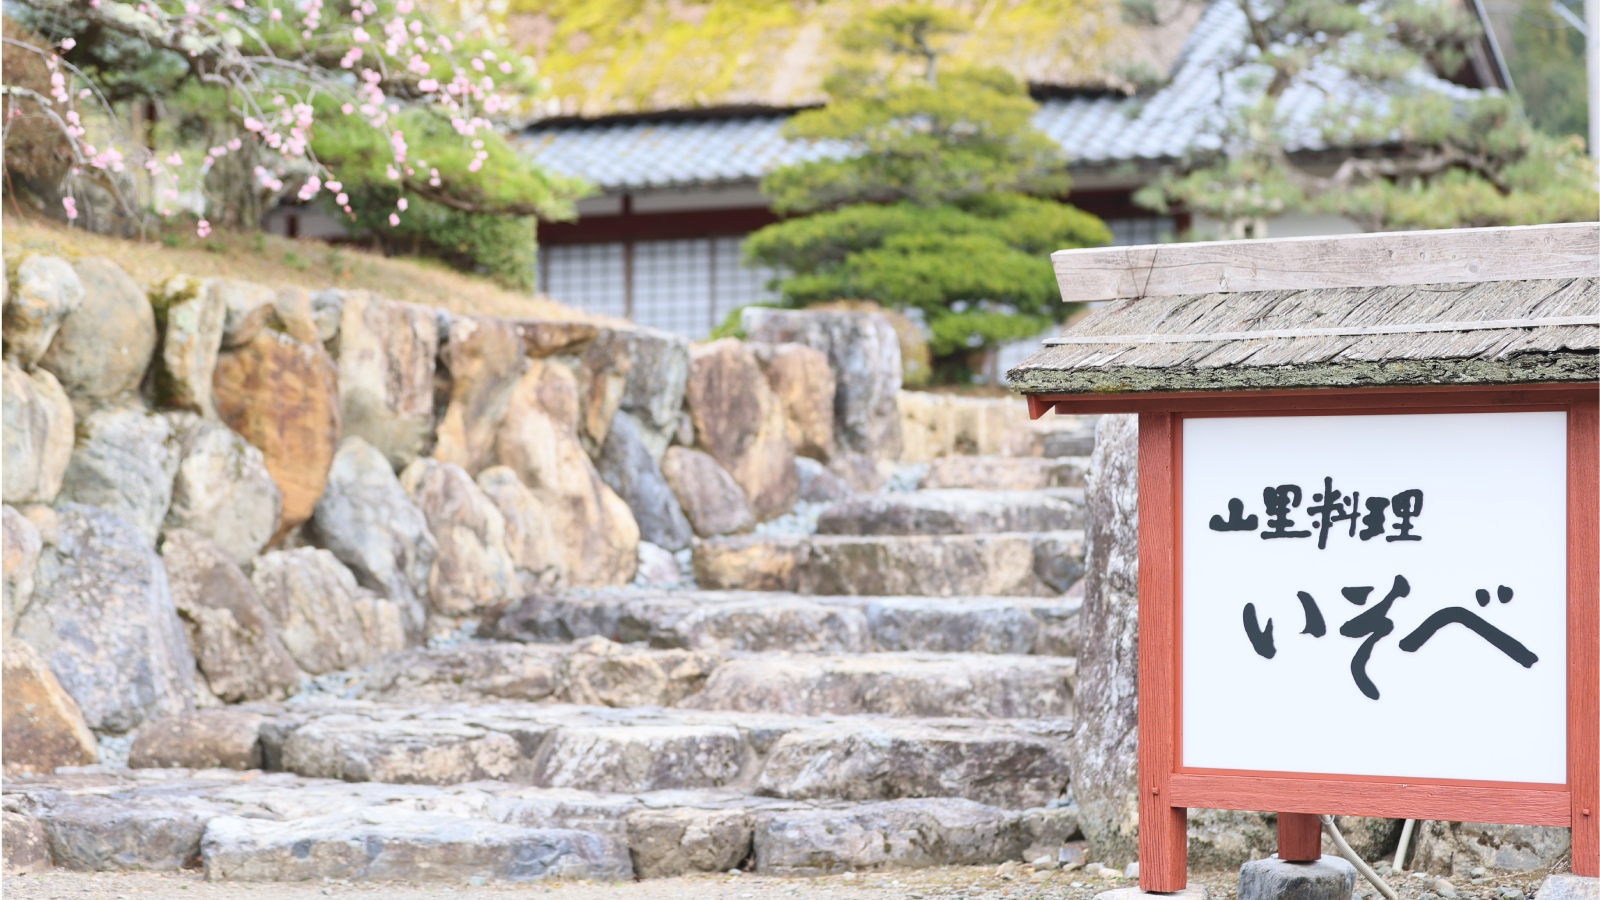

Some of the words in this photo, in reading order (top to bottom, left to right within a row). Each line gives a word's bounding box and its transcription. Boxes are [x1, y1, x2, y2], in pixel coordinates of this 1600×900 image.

[1209, 476, 1424, 549] 山里料理
[1242, 574, 1539, 700] いそべ
